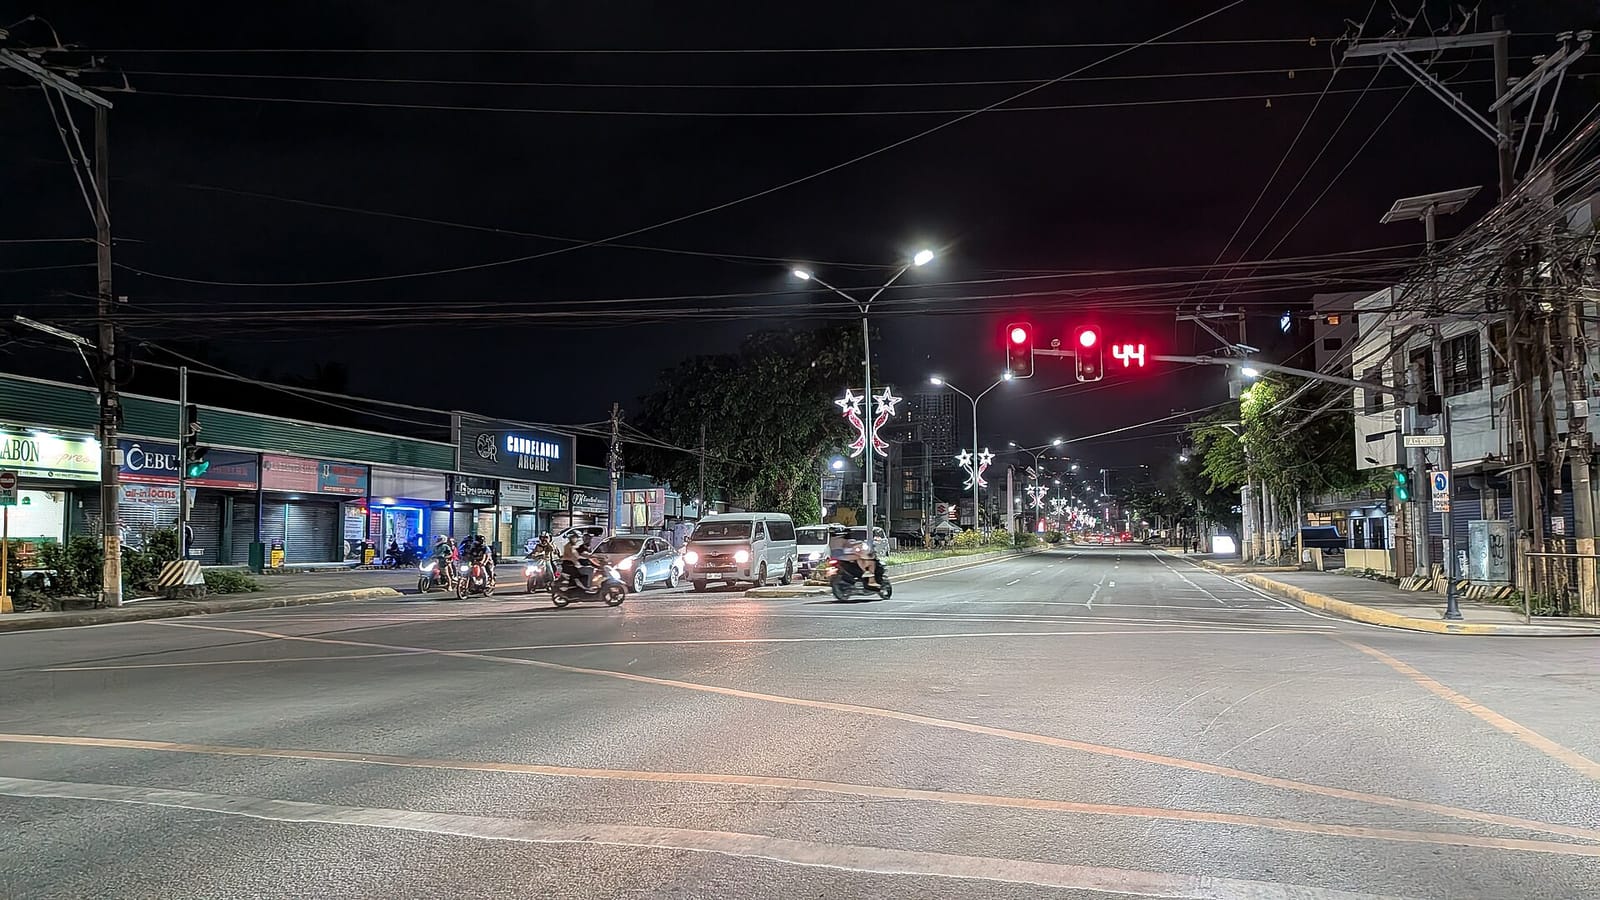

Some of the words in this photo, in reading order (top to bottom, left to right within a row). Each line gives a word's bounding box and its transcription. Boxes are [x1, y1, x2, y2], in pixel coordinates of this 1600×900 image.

[1112, 343, 1145, 367] 44
[126, 443, 179, 472] CEBU
[506, 435, 560, 459] CANDELARIA
[518, 454, 550, 472] ARCADE
[148, 487, 177, 499] loans
